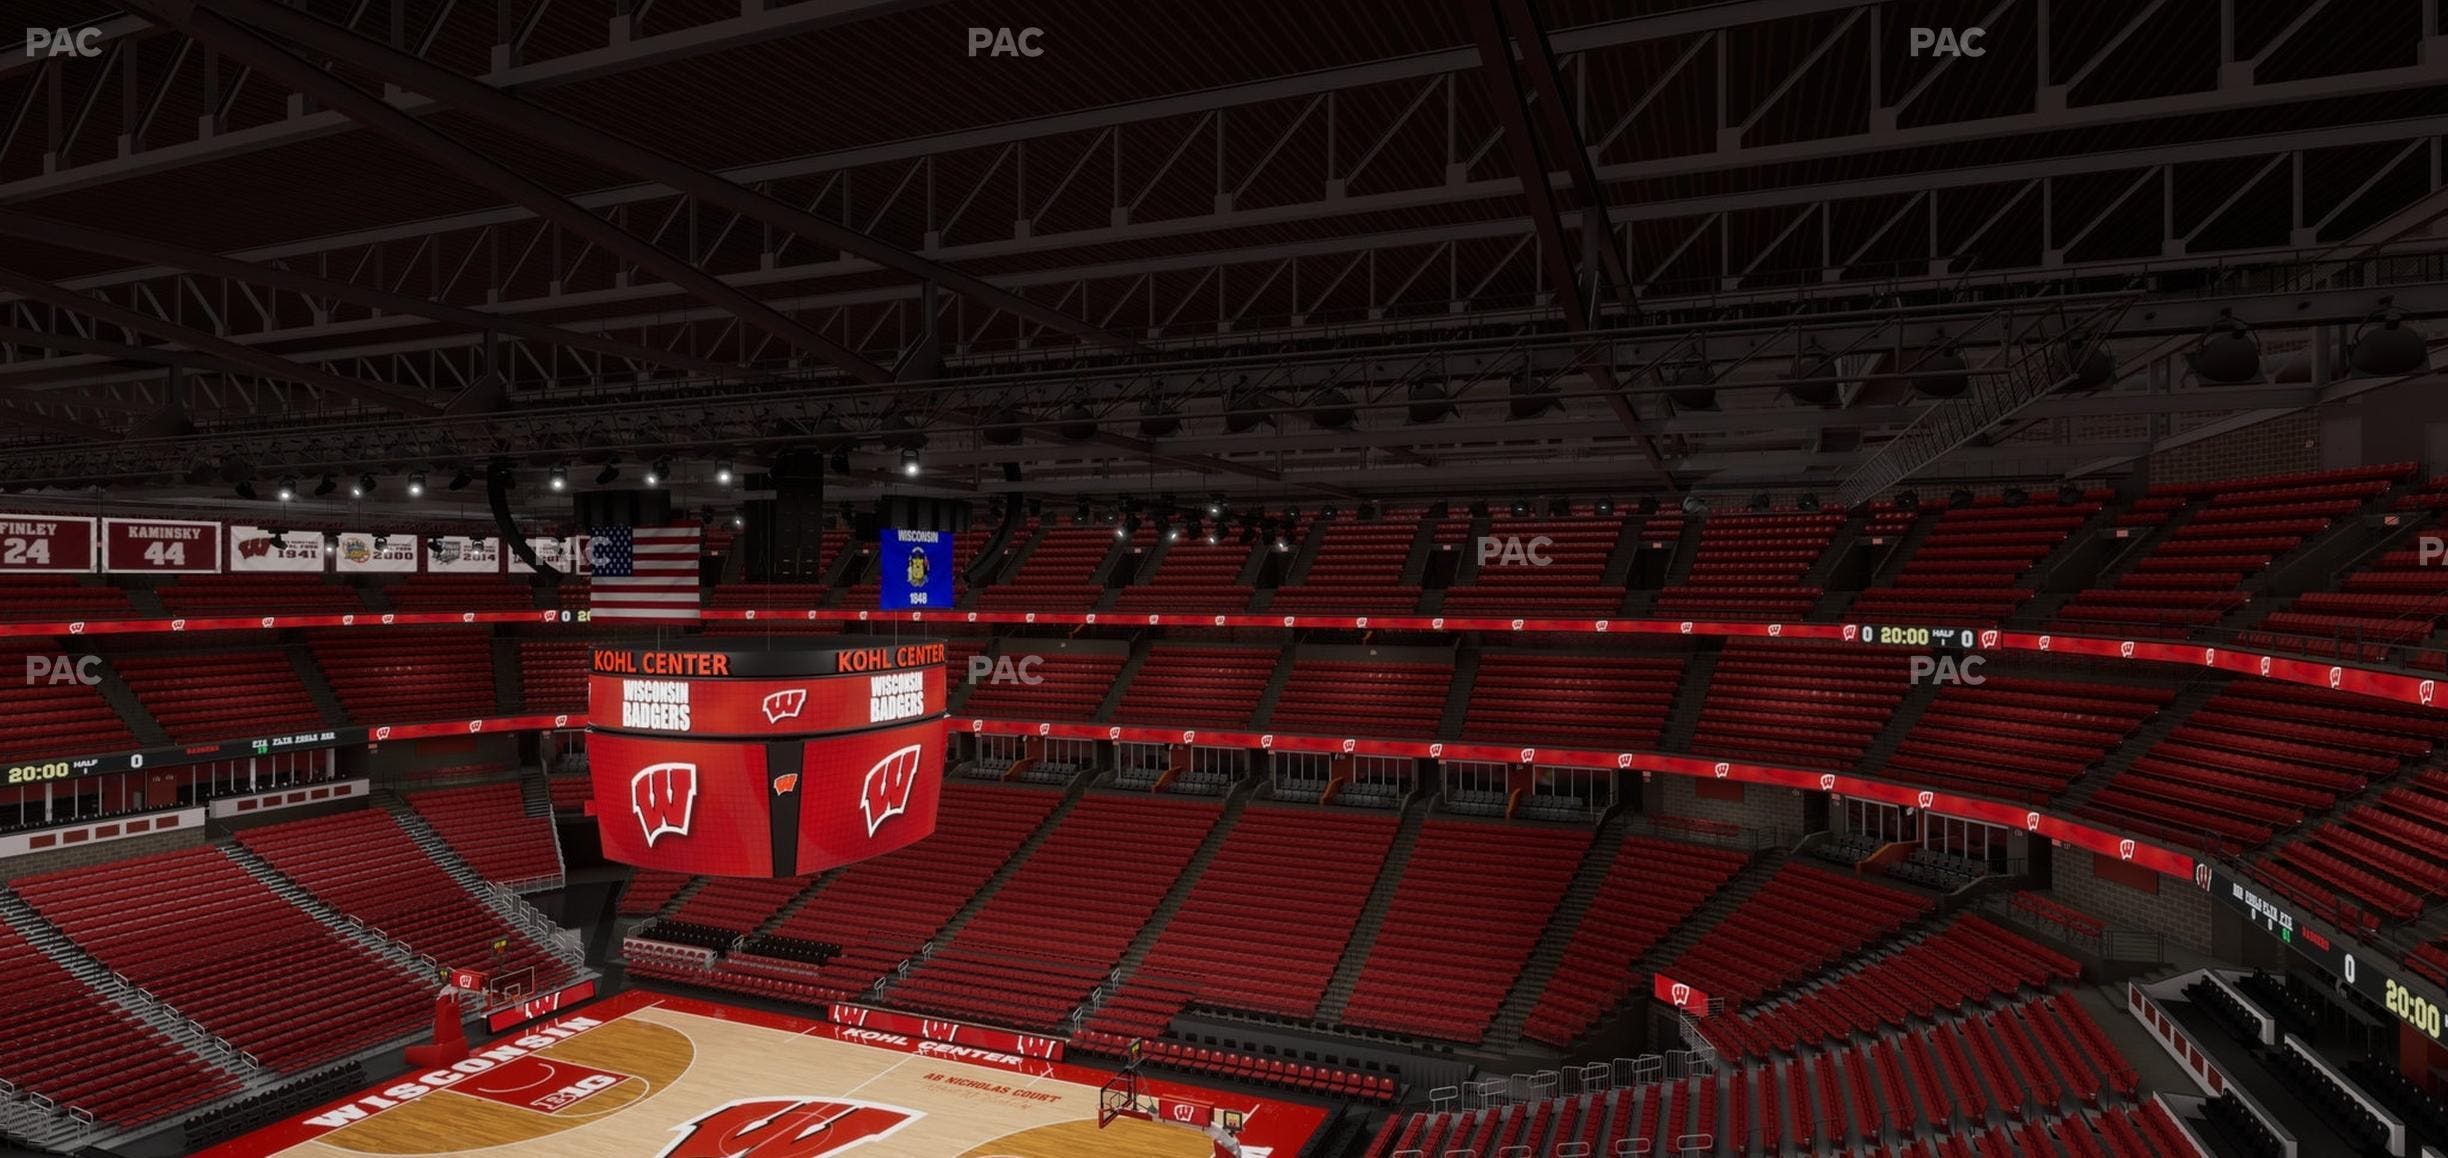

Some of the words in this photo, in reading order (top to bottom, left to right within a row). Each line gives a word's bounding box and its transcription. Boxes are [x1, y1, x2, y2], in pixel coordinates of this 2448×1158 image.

[0, 522, 57, 536] FINLEY
[128, 526, 201, 540] KAMINSKY
[898, 529, 939, 543] WISCONSIN
[4, 538, 50, 564] 24
[144, 541, 185, 565] 44
[278, 549, 317, 559] 1941
[373, 551, 414, 560] 2000
[463, 553, 496, 561] 2014
[910, 592, 927, 604] 1848
[262, 617, 274, 628] W
[343, 615, 353, 625] W
[382, 614, 394, 624] W
[463, 613, 474, 622] W
[543, 609, 557, 623] W
[561, 610, 571, 622] 0
[1149, 615, 1158, 624] W
[1215, 616, 1225, 625] W
[1284, 617, 1294, 626] W
[1357, 617, 1367, 628] W
[70, 622, 84, 634] W
[172, 620, 185, 630] W
[1432, 618, 1443, 629] W
[1512, 619, 1523, 630] W
[1596, 621, 1608, 631] W
[1681, 622, 1692, 633] W
[1768, 624, 1781, 636] W
[1842, 624, 1857, 641] W
[1862, 625, 1873, 643] 0
[1880, 626, 1929, 646] 20:00
[1932, 629, 1955, 638] HALF
[1961, 630, 1974, 648] 0
[1981, 630, 1999, 649] W
[2039, 636, 2050, 650] W
[2121, 642, 2134, 657] W
[2206, 648, 2214, 665] W
[594, 650, 637, 673] KOHL
[642, 652, 729, 676] CENTER
[838, 648, 891, 671] KOHL
[896, 643, 945, 664] CENTER
[2261, 657, 2270, 675] W
[871, 671, 924, 698] WISCONSIN
[2330, 667, 2341, 688] W
[622, 679, 690, 705] WISCONSIN
[2420, 680, 2434, 704] W
[762, 689, 807, 724] W
[870, 691, 925, 724] BADGERS
[555, 715, 567, 727] W
[622, 703, 691, 731] BADGERS
[470, 720, 482, 733] W
[973, 720, 982, 732] W
[1040, 723, 1050, 736] W
[1110, 727, 1120, 739] W
[377, 727, 390, 740] W
[1184, 731, 1194, 744] W
[1261, 735, 1273, 748] W
[1343, 739, 1355, 752] W
[1430, 744, 1442, 757] W
[1521, 748, 1534, 763] W
[1618, 754, 1632, 768] W
[8, 762, 69, 783] 20:00
[73, 759, 98, 768] HALF
[130, 754, 143, 768] 0
[1715, 763, 1729, 778] W
[773, 773, 798, 796] W
[1821, 774, 1835, 790] W
[859, 744, 922, 838] W
[631, 762, 697, 848] W
[1919, 791, 1933, 808] W
[2027, 812, 2039, 830] W
[2120, 839, 2135, 859] W
[459, 975, 472, 988] W
[1672, 983, 1690, 1006] W
[2344, 953, 2356, 984] 0
[2385, 978, 2440, 1039] 20:00
[842, 1027, 910, 1046] KOHL
[914, 1040, 1024, 1065] CENTER
[302, 1016, 603, 1128] WISCONSIN
[923, 1072, 943, 1083] AB
[944, 1075, 1011, 1095] NICHOLAS
[1012, 1088, 1062, 1103] COURT
[1173, 1104, 1195, 1122] W
